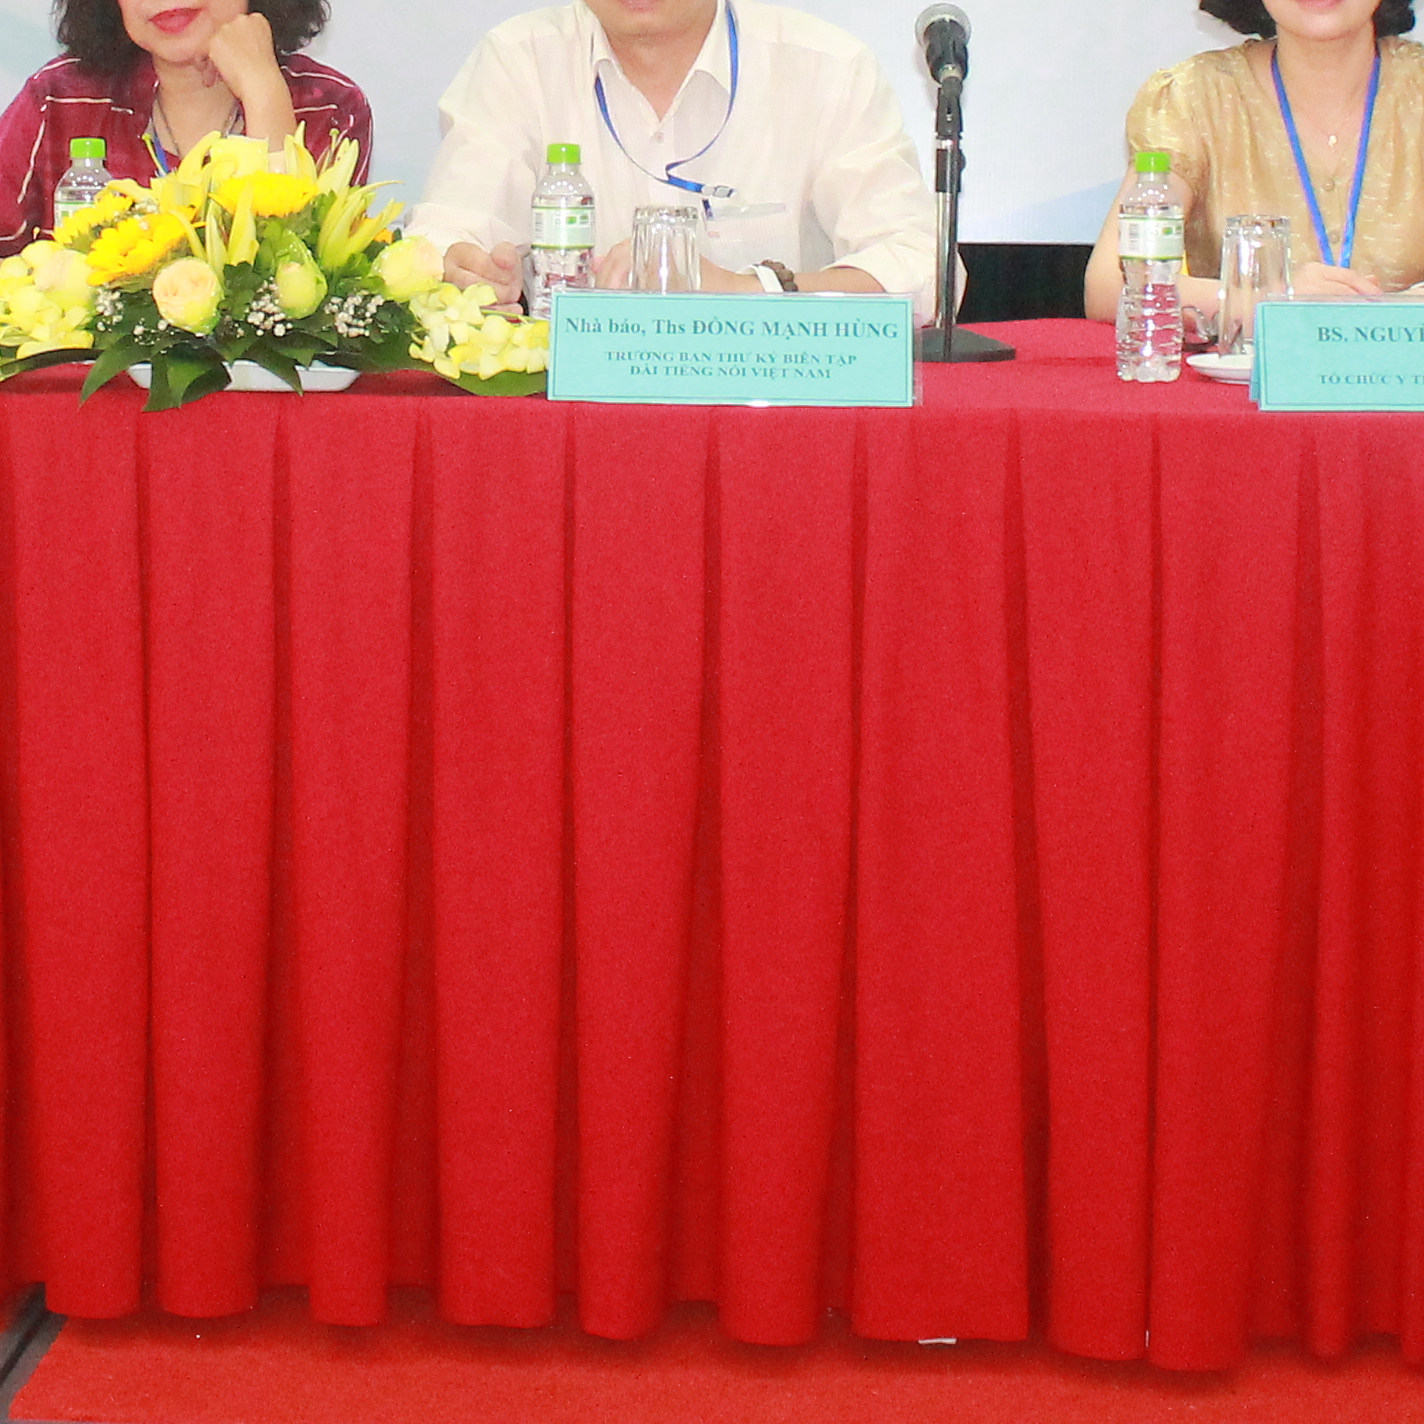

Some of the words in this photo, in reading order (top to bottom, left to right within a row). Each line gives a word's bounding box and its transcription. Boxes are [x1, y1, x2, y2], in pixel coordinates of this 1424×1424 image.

[565, 316, 602, 334] Nhà
[607, 318, 647, 336] báo,
[652, 318, 686, 335] Ths
[760, 321, 828, 341] MẠNH
[833, 317, 899, 339] HÙNG
[1316, 326, 1349, 343] BS.
[678, 352, 713, 363] BAN
[716, 364, 748, 378] NÓI
[794, 367, 832, 380] NAM
